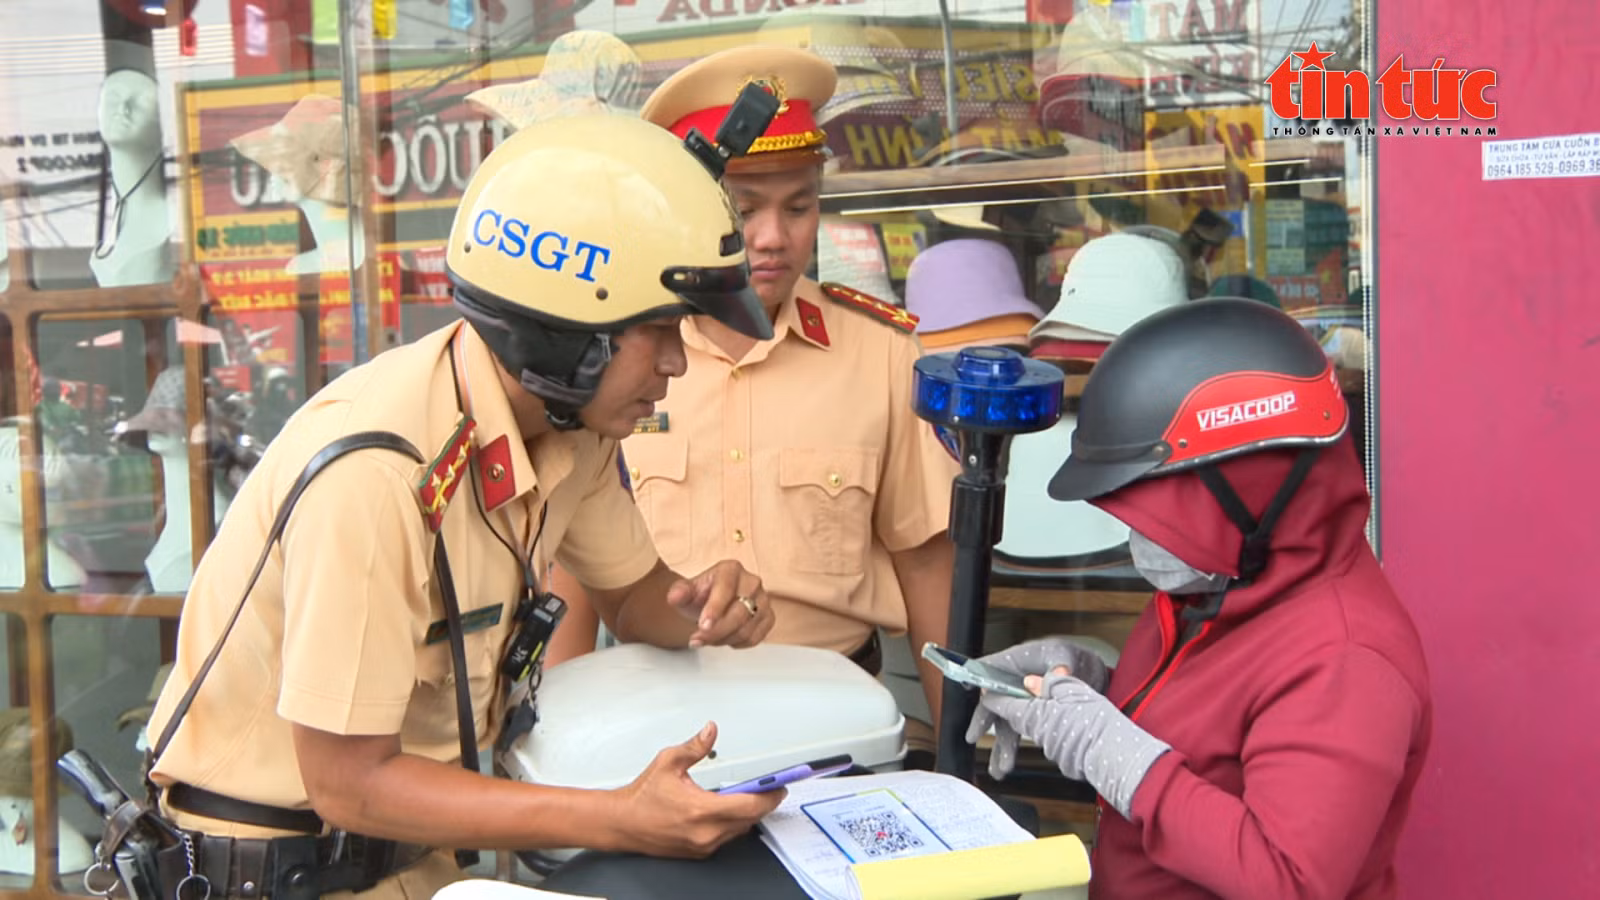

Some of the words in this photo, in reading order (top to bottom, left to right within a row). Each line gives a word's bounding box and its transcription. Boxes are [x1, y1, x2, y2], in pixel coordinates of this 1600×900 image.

[1489, 143, 1518, 153] TRUNG
[473, 209, 611, 282] CSGT
[1196, 390, 1297, 432] VISACOOP
